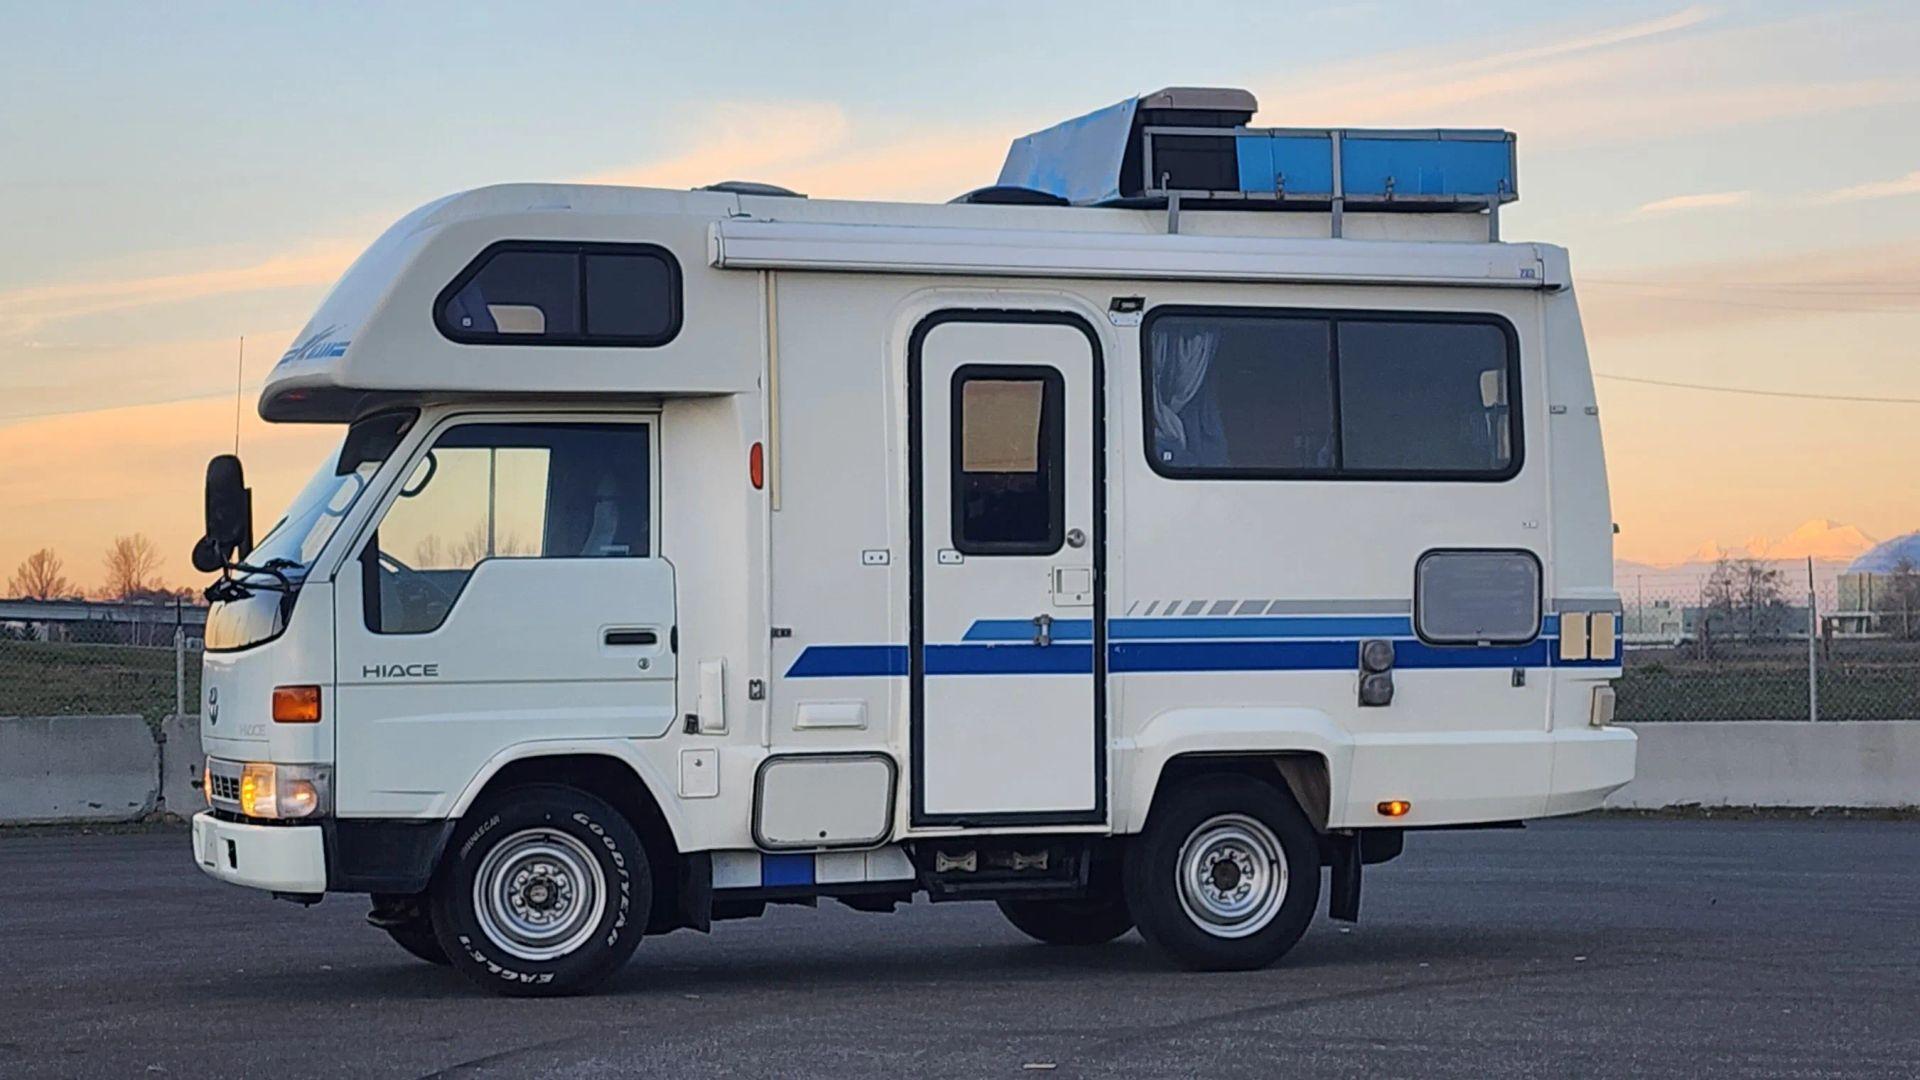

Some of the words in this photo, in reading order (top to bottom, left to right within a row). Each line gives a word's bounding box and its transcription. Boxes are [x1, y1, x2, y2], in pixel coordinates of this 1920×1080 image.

[363, 664, 438, 677] HIACE
[573, 812, 630, 946] GOODYEAR
[470, 950, 554, 984] EAGLE
